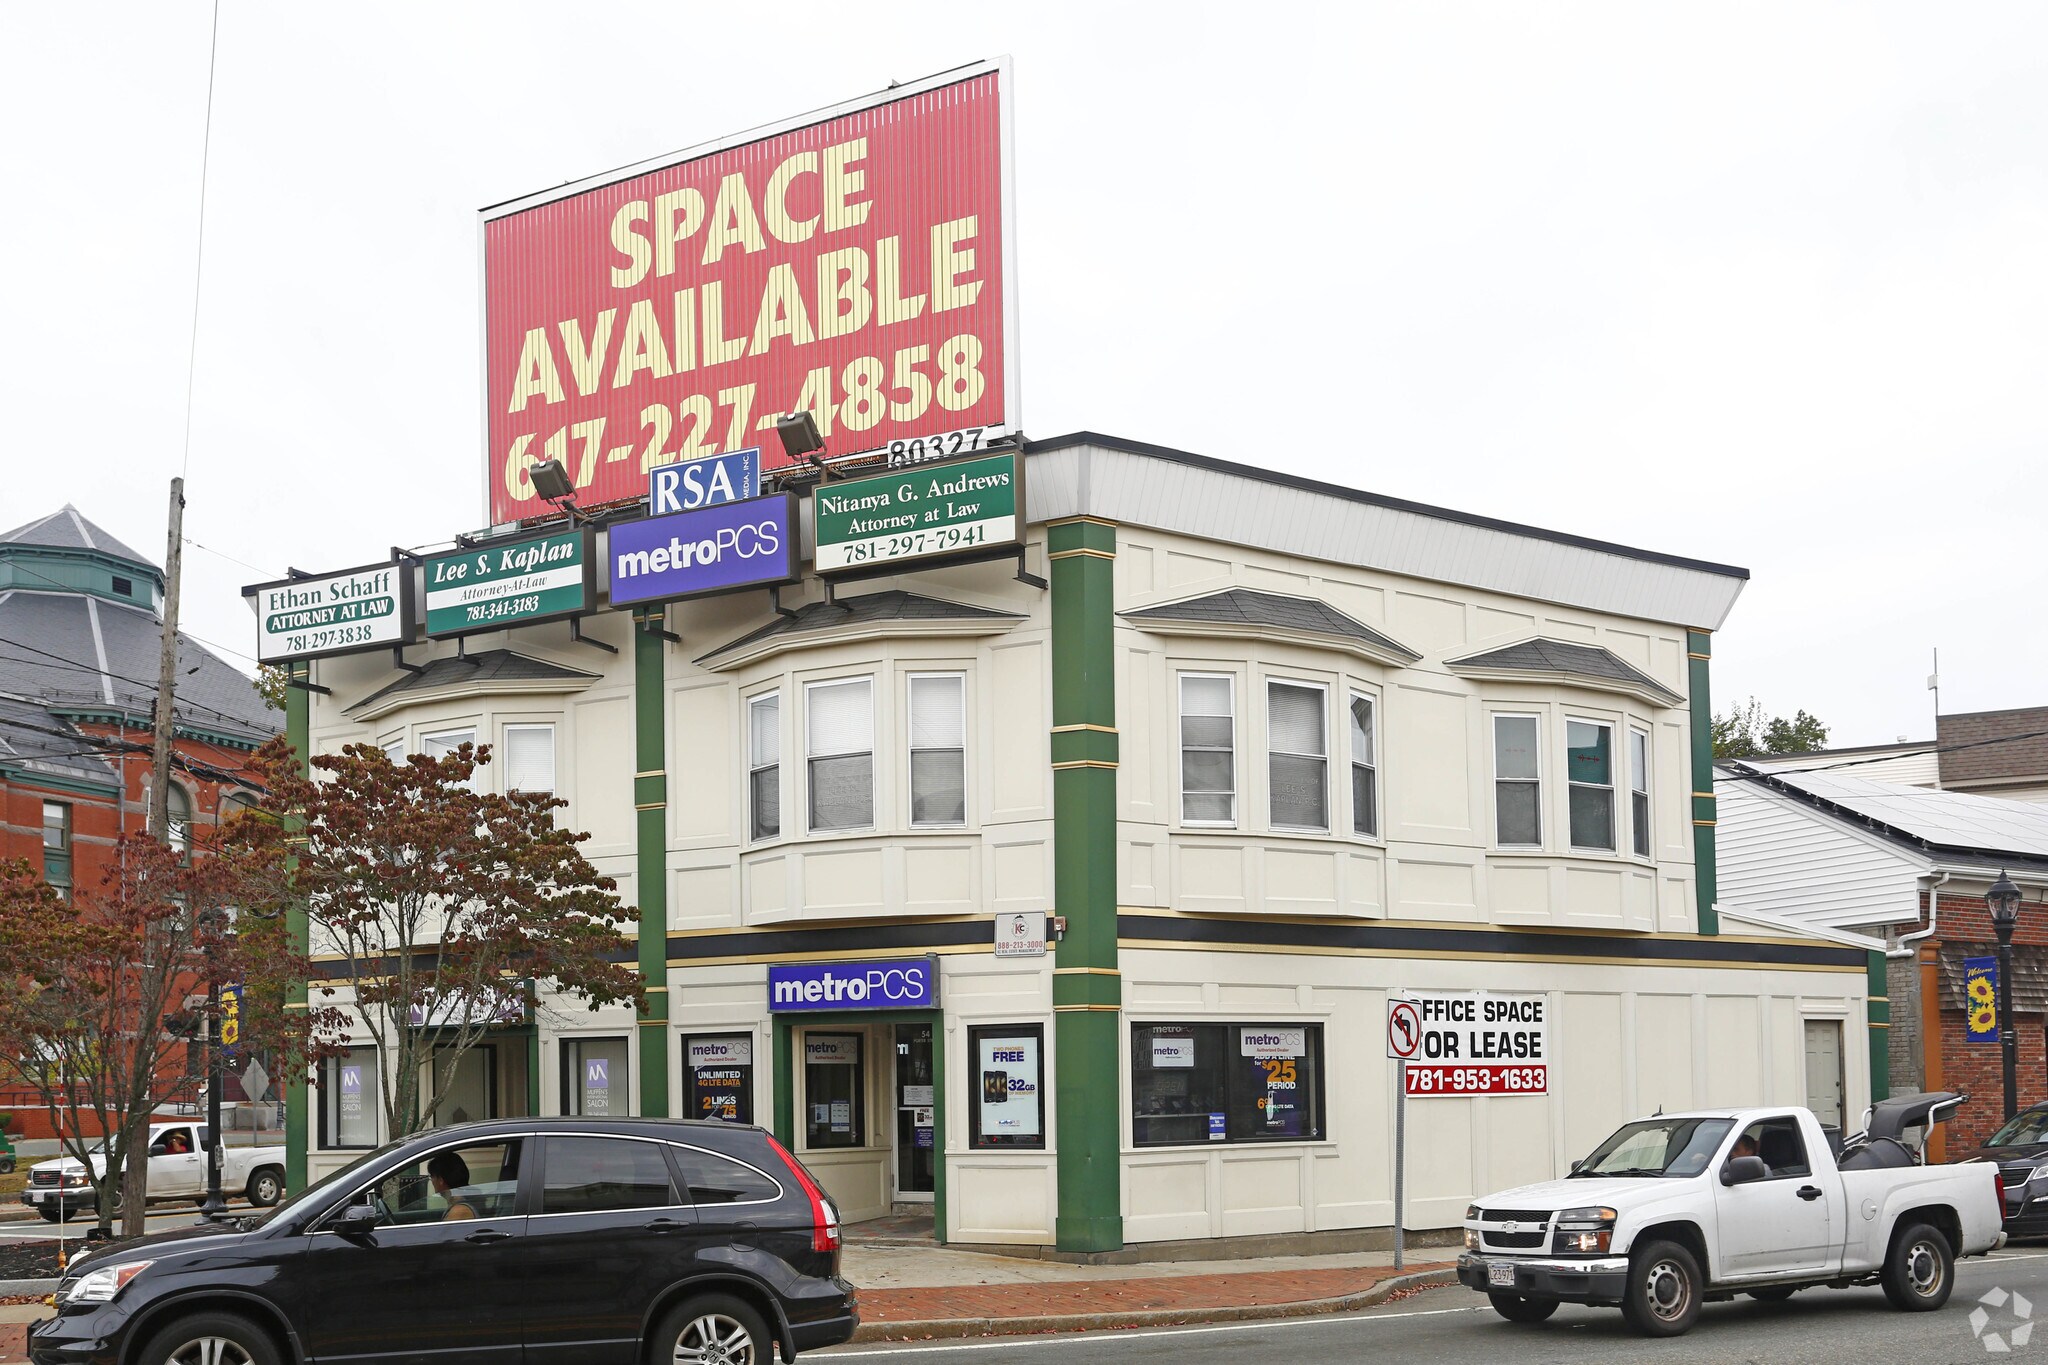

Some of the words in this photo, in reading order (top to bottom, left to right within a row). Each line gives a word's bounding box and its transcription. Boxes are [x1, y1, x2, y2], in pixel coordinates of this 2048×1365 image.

[610, 136, 874, 289] SPACE
[508, 213, 985, 415] AVAILABLE
[504, 333, 985, 503] 617-227-4858
[890, 428, 984, 468] 80327
[656, 459, 736, 514] RSA
[821, 493, 890, 516] Nitanya
[897, 484, 919, 503] G.
[926, 472, 1010, 499] Andrews
[847, 512, 918, 535] Attorney
[924, 508, 940, 522] at
[947, 502, 981, 518] Law
[618, 520, 779, 579] metroPCS
[843, 524, 986, 564] 781-297-7941
[434, 562, 467, 583] Lee
[475, 555, 491, 575] S.
[500, 541, 574, 573] Kaplan
[269, 589, 322, 612] Ethan
[329, 571, 390, 602] Schaff
[460, 576, 548, 601] Attorney-At-Law
[271, 608, 337, 630] ATTORNEY
[340, 604, 357, 620] AT
[361, 599, 389, 616] LAW
[466, 595, 539, 622] 781-341-3183
[286, 624, 372, 652] 781-297-3838
[997, 940, 1043, 950] 888-213-3000
[1966, 967, 1994, 977] Welcome
[775, 968, 924, 1003] metroPCS
[1410, 999, 1476, 1022] FFICE
[1484, 1001, 1543, 1023] SPACE
[921, 1030, 930, 1038] 54
[1245, 1033, 1300, 1046] metroPCS
[1422, 1031, 1460, 1058] OR
[1470, 1031, 1542, 1058] LEASE
[692, 1042, 749, 1056] metroPCS
[993, 1051, 1025, 1062] FREE
[1154, 1047, 1194, 1056] metroPCS
[697, 1070, 741, 1079] UNLIMITED
[697, 1079, 708, 1087] 4G
[722, 1078, 741, 1086] DATA
[1261, 1060, 1297, 1082] $25
[1407, 1068, 1545, 1091] 781-953-1633
[1008, 1079, 1035, 1091] 32GB
[1267, 1082, 1296, 1090] PERIOD
[342, 1103, 362, 1111] SALON
[587, 1099, 609, 1107] SALON
[703, 1096, 712, 1109] 2
[711, 1095, 737, 1105] LINES
